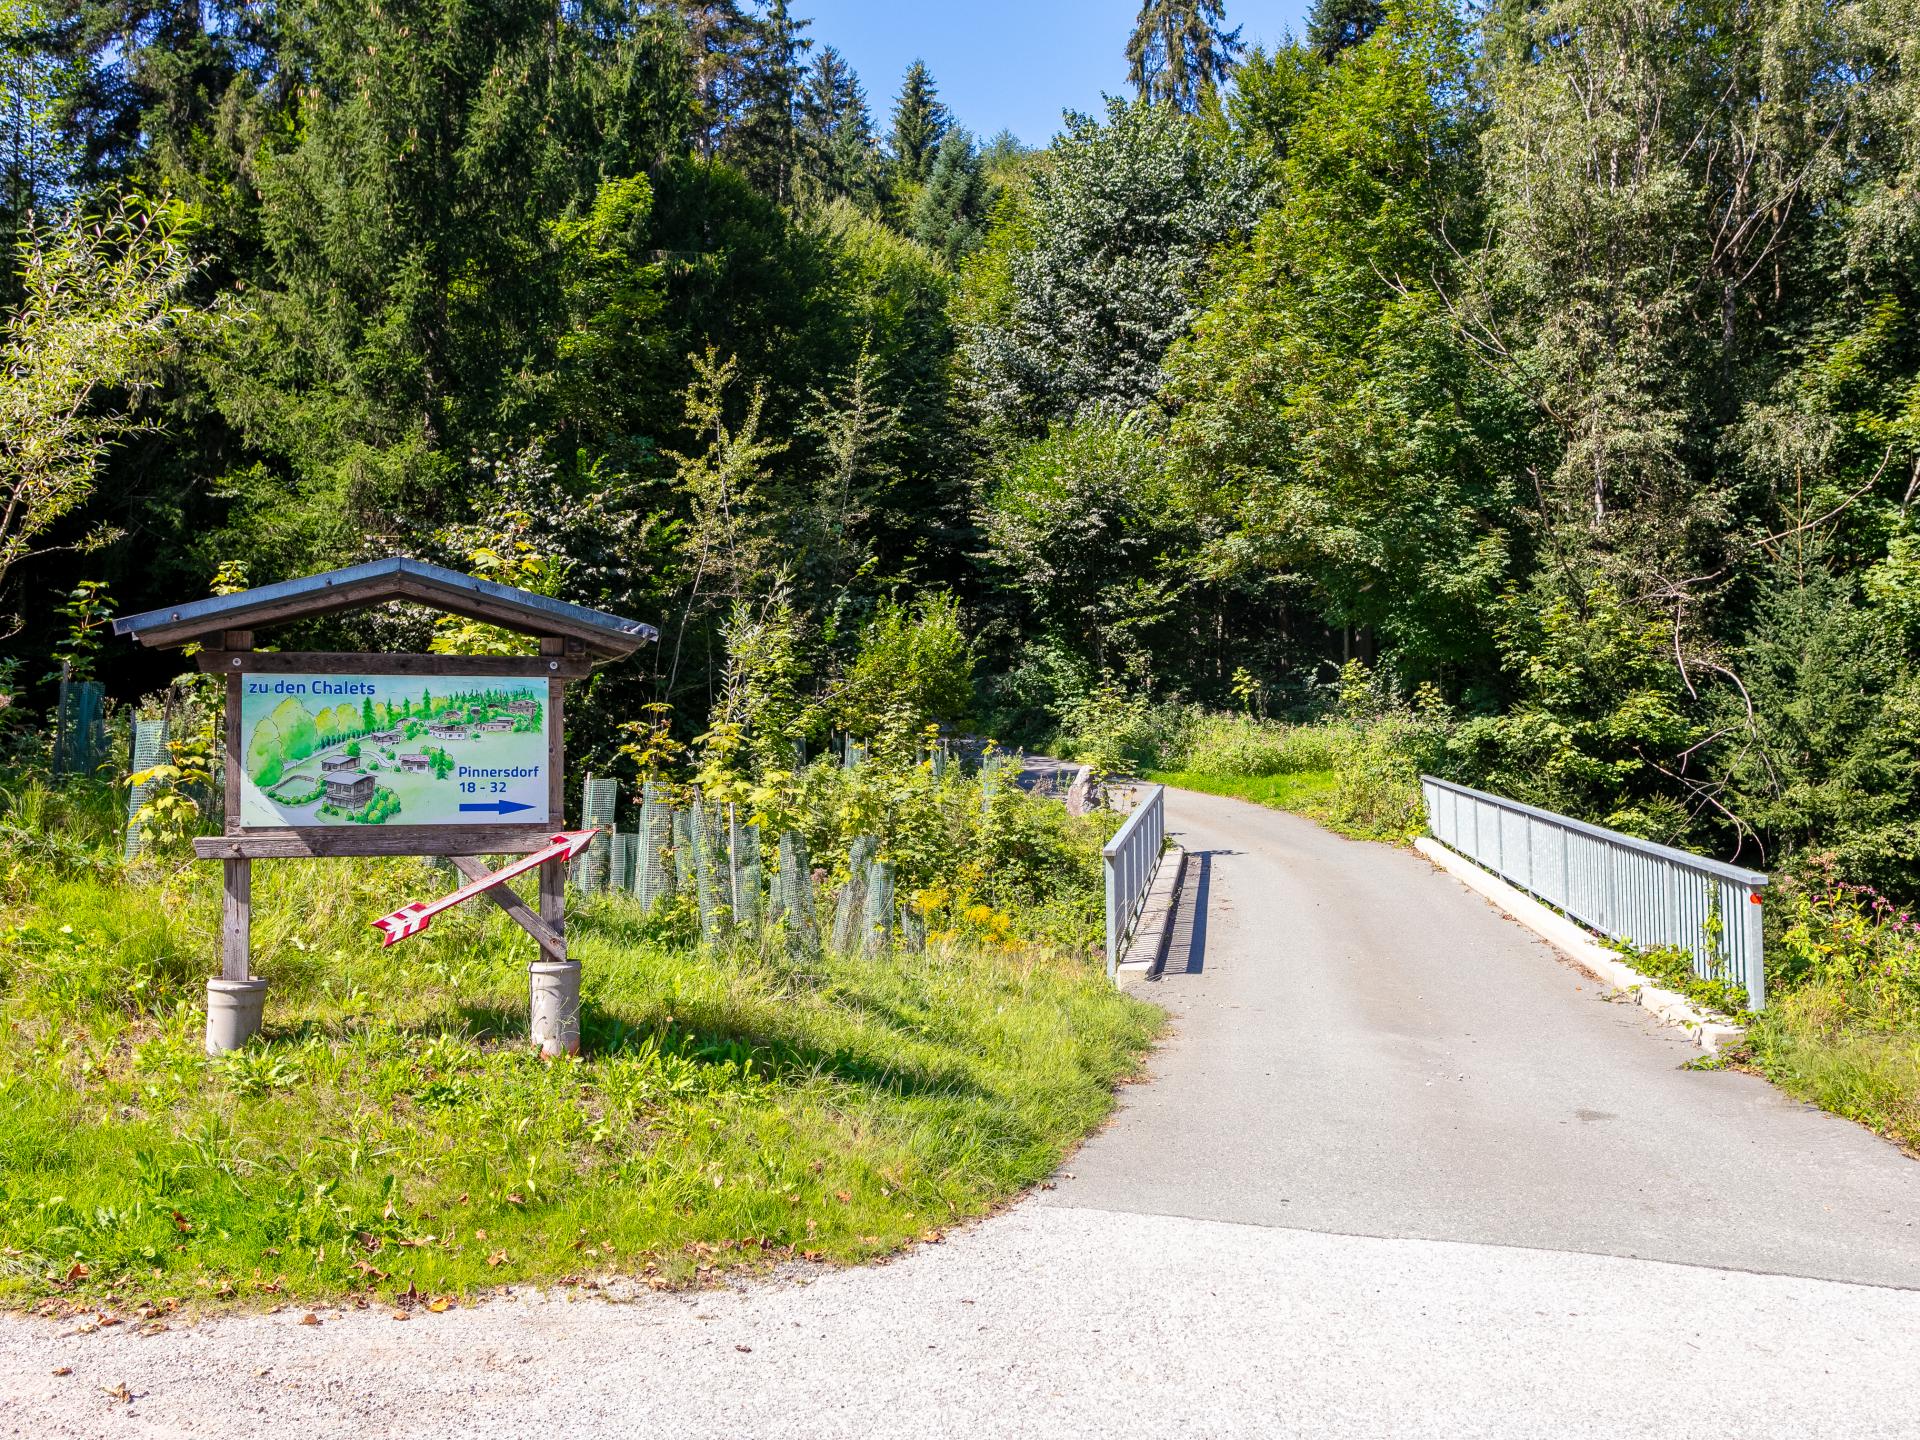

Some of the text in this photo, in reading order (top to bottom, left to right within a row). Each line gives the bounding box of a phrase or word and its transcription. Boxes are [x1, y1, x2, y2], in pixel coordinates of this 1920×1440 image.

[249, 680, 376, 695] zu den Chalets
[458, 766, 539, 778] Pinnersdorf
[459, 782, 476, 793] 18
[490, 782, 507, 793] 32
